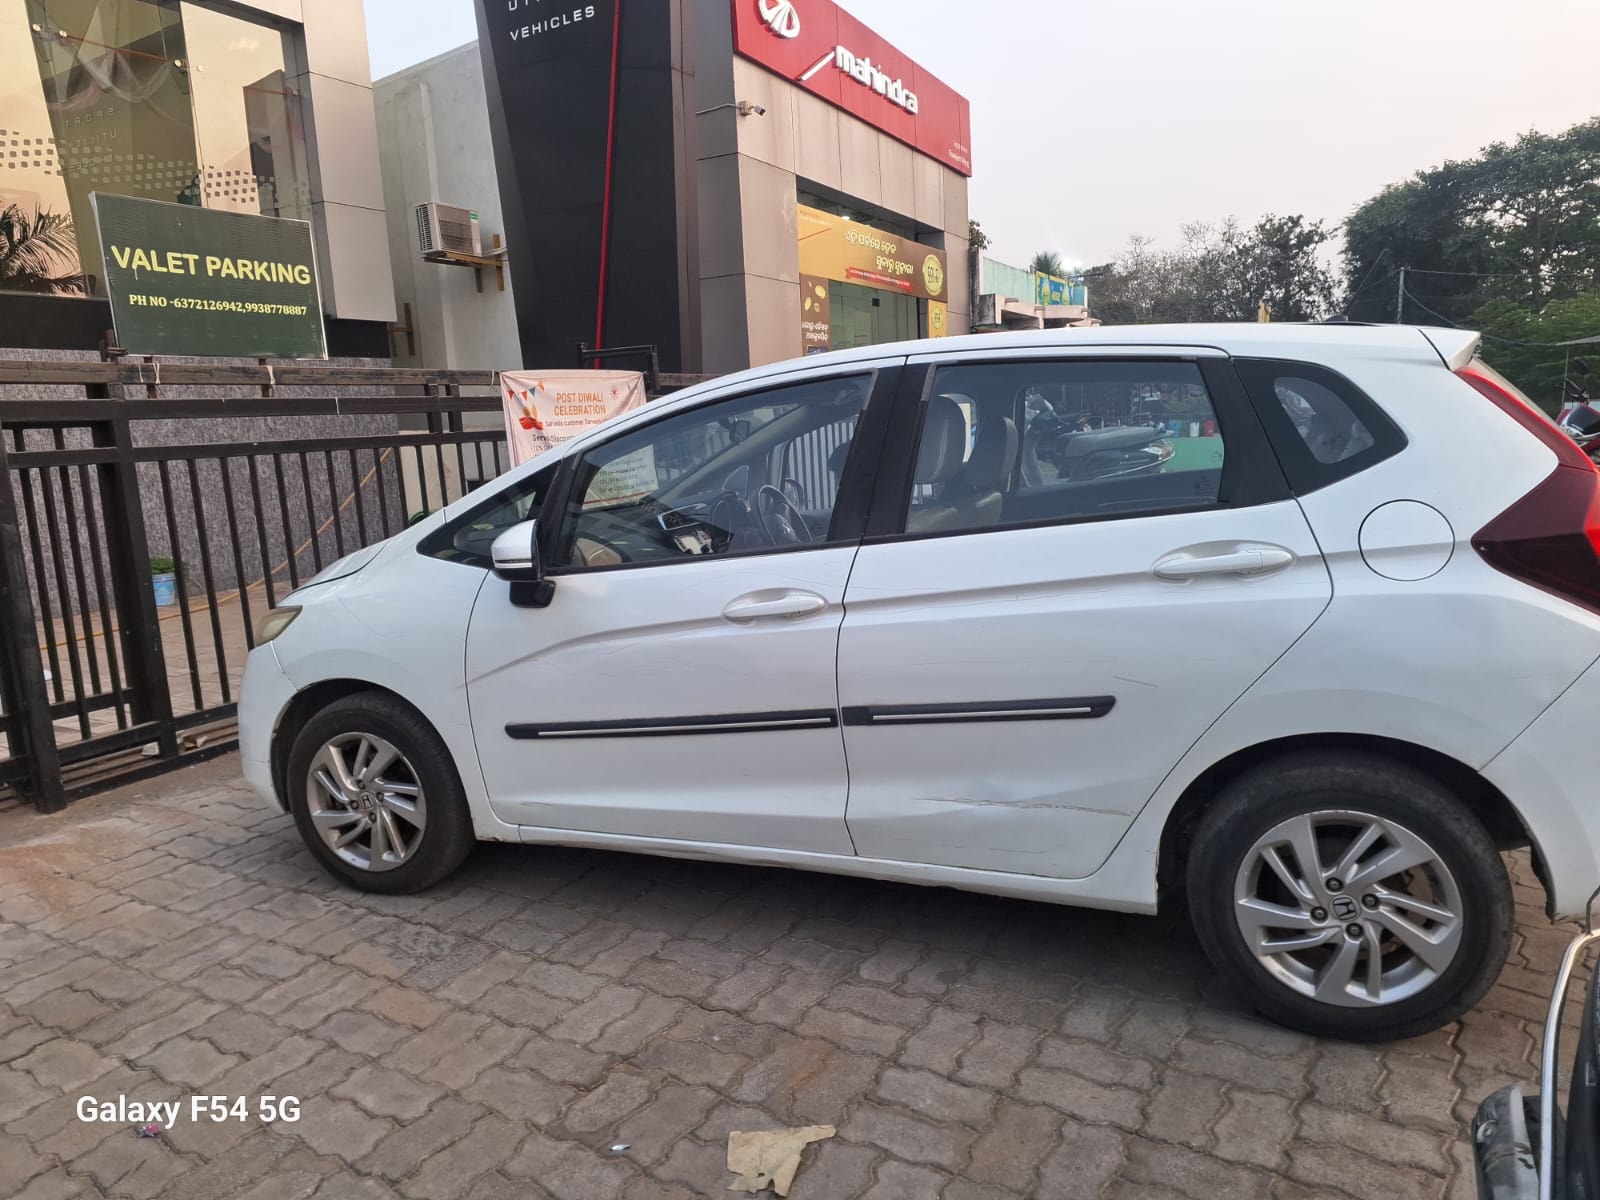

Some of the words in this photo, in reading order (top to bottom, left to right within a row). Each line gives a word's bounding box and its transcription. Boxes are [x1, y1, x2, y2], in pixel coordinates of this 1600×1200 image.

[510, 5, 595, 41] VEHICLES
[836, 45, 918, 114] mahindra
[111, 245, 199, 275] VALET
[205, 255, 311, 285] PARKING
[129, 294, 147, 306] PH
[150, 296, 167, 307] NO
[556, 392, 576, 403] POST
[578, 391, 604, 403] DIWALI
[554, 405, 606, 416] CELEBRATION
